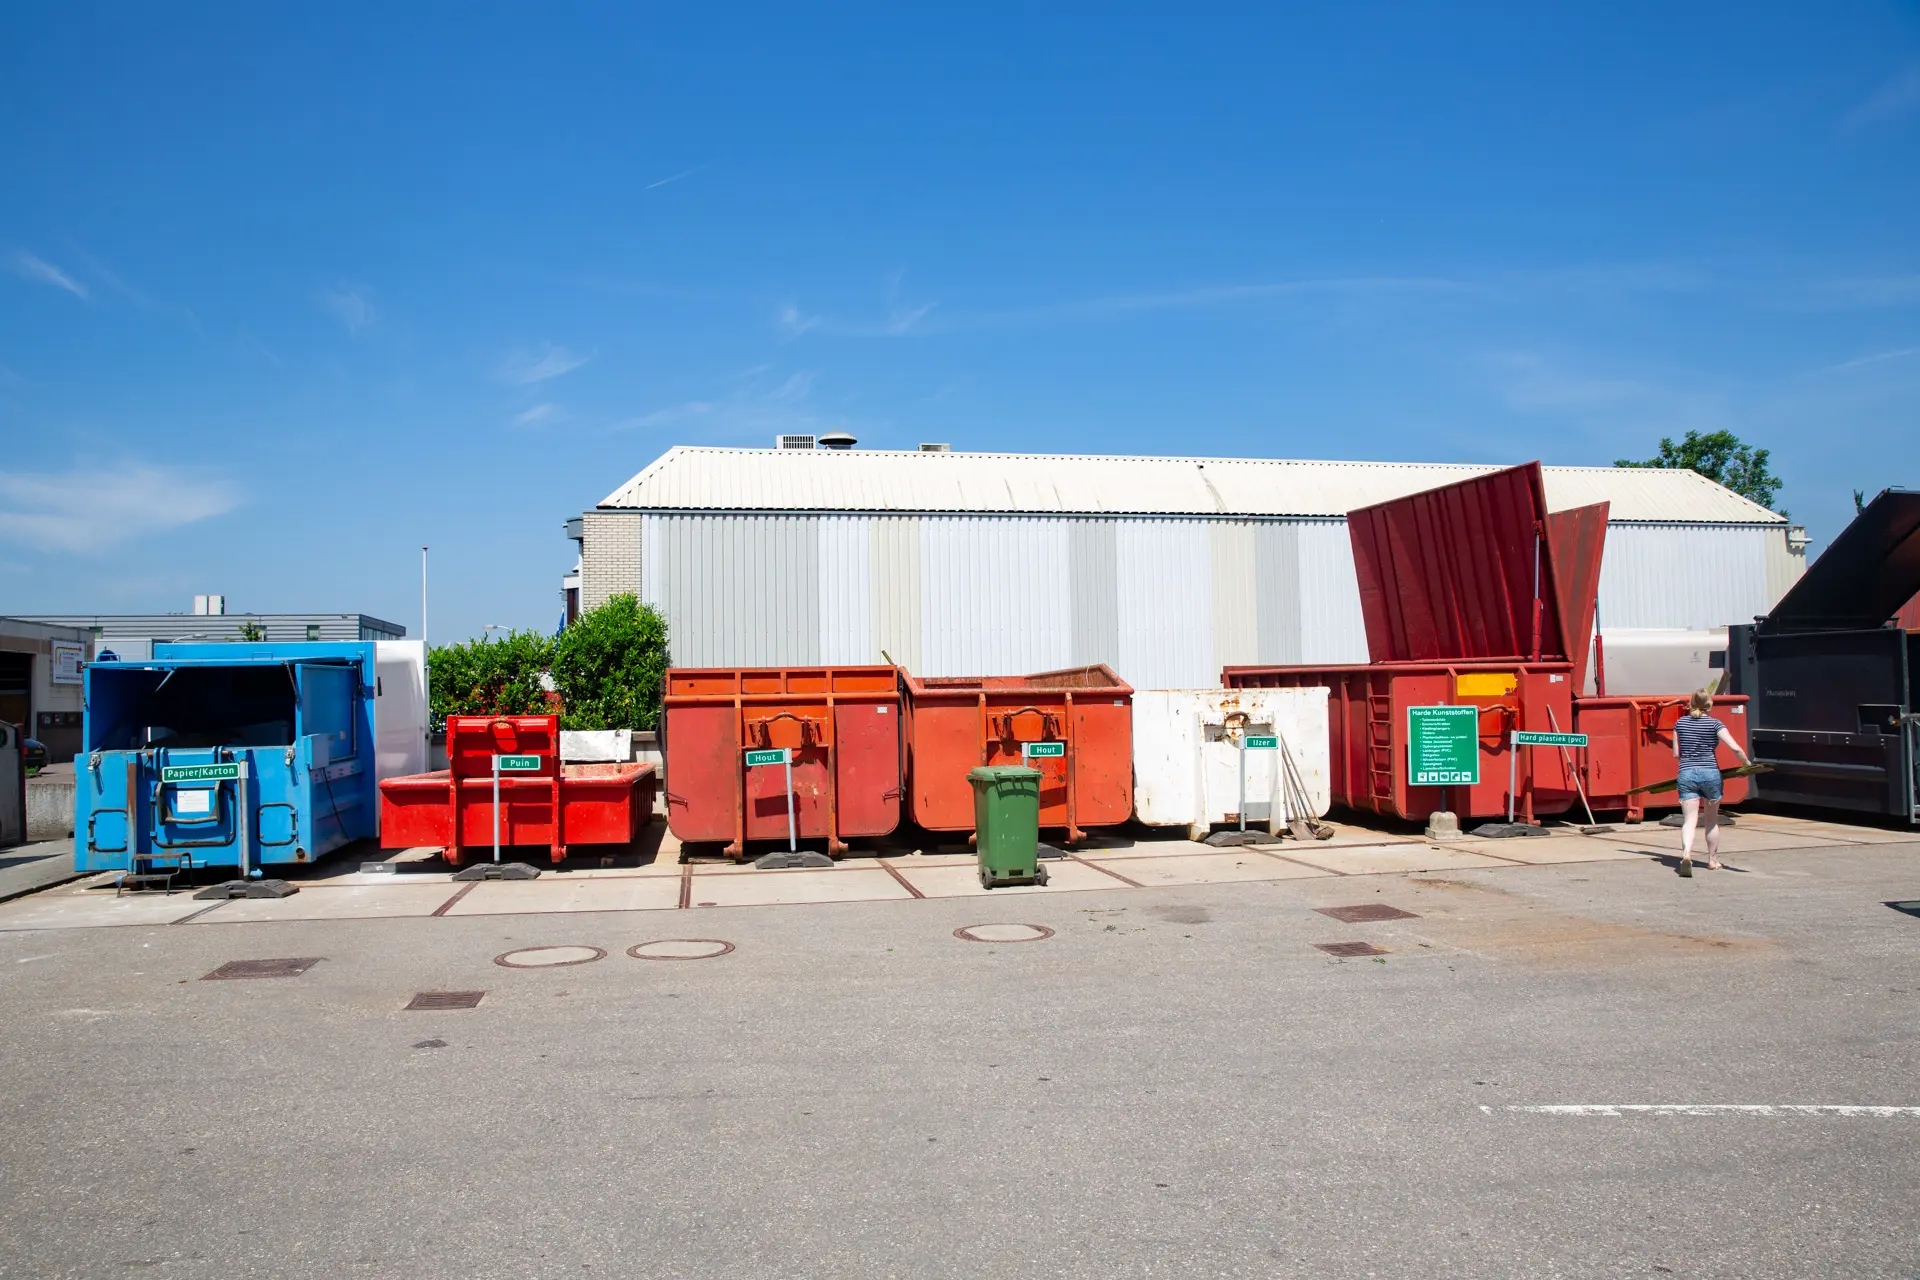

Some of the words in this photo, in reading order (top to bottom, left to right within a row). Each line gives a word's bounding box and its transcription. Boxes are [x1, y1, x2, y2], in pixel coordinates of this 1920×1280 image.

[1538, 734, 1566, 742] plastiek
[1567, 736, 1585, 744] (pvc)
[1036, 746, 1056, 754] Hout
[510, 758, 530, 767] Puin
[755, 754, 776, 762] Hout
[167, 767, 235, 778] Papier/Karton
